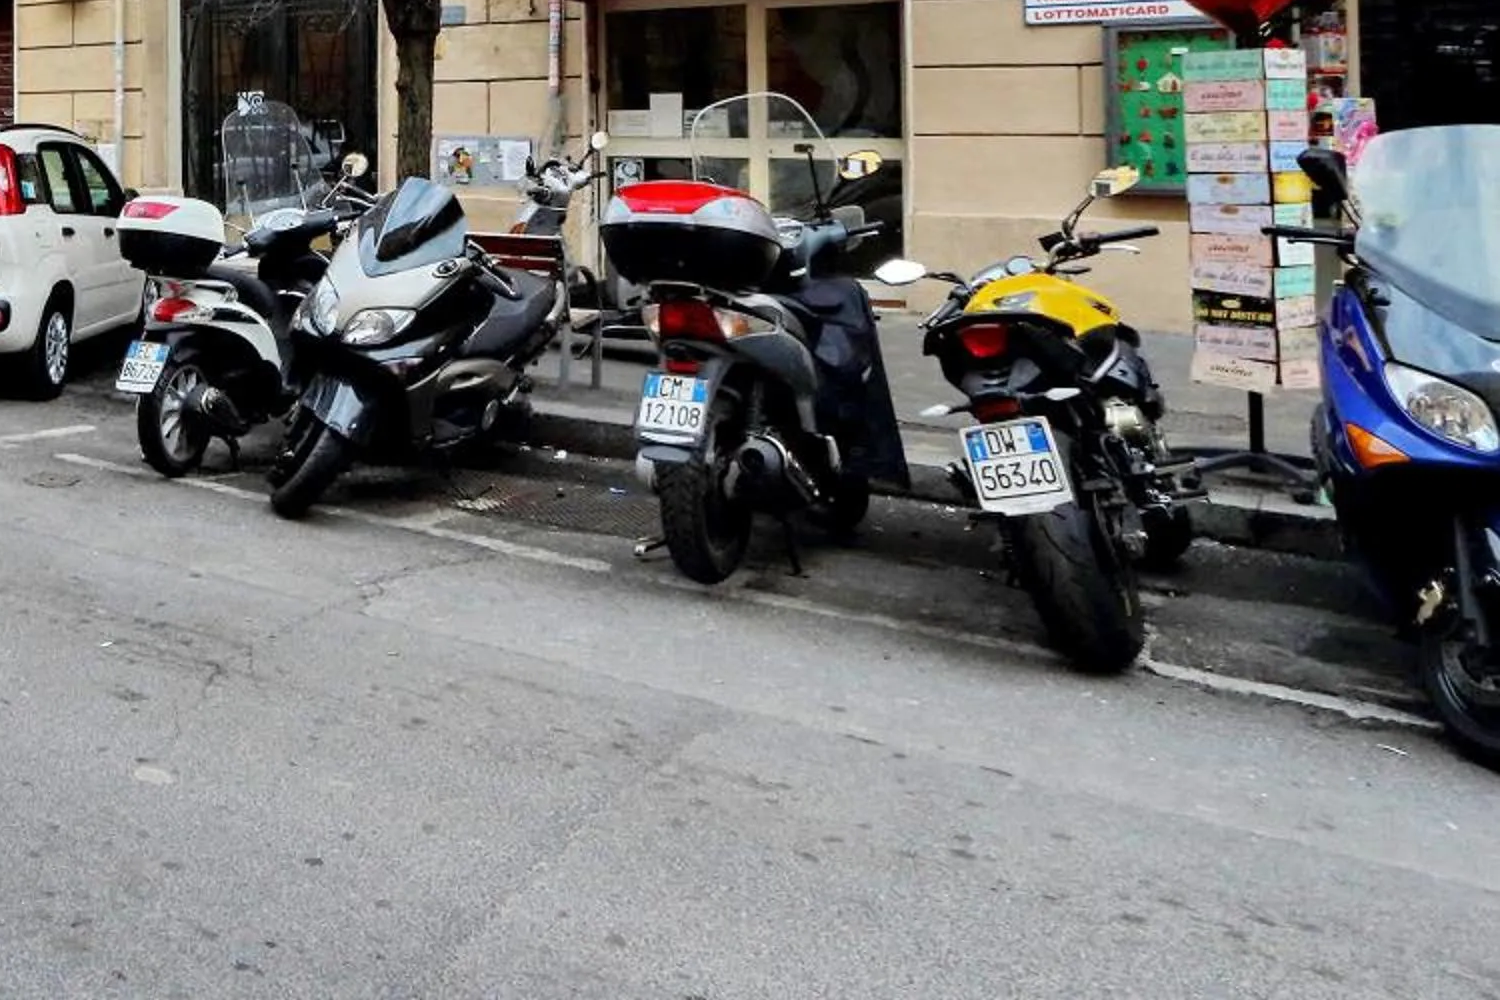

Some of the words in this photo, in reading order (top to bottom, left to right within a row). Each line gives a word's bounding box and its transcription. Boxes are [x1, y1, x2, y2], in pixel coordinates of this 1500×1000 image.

[1034, 5, 1170, 21] LOTTOMATICARD
[659, 378, 683, 399] CM
[646, 402, 701, 429] 12108
[985, 425, 1017, 455] DW
[981, 458, 1058, 492] 56340
